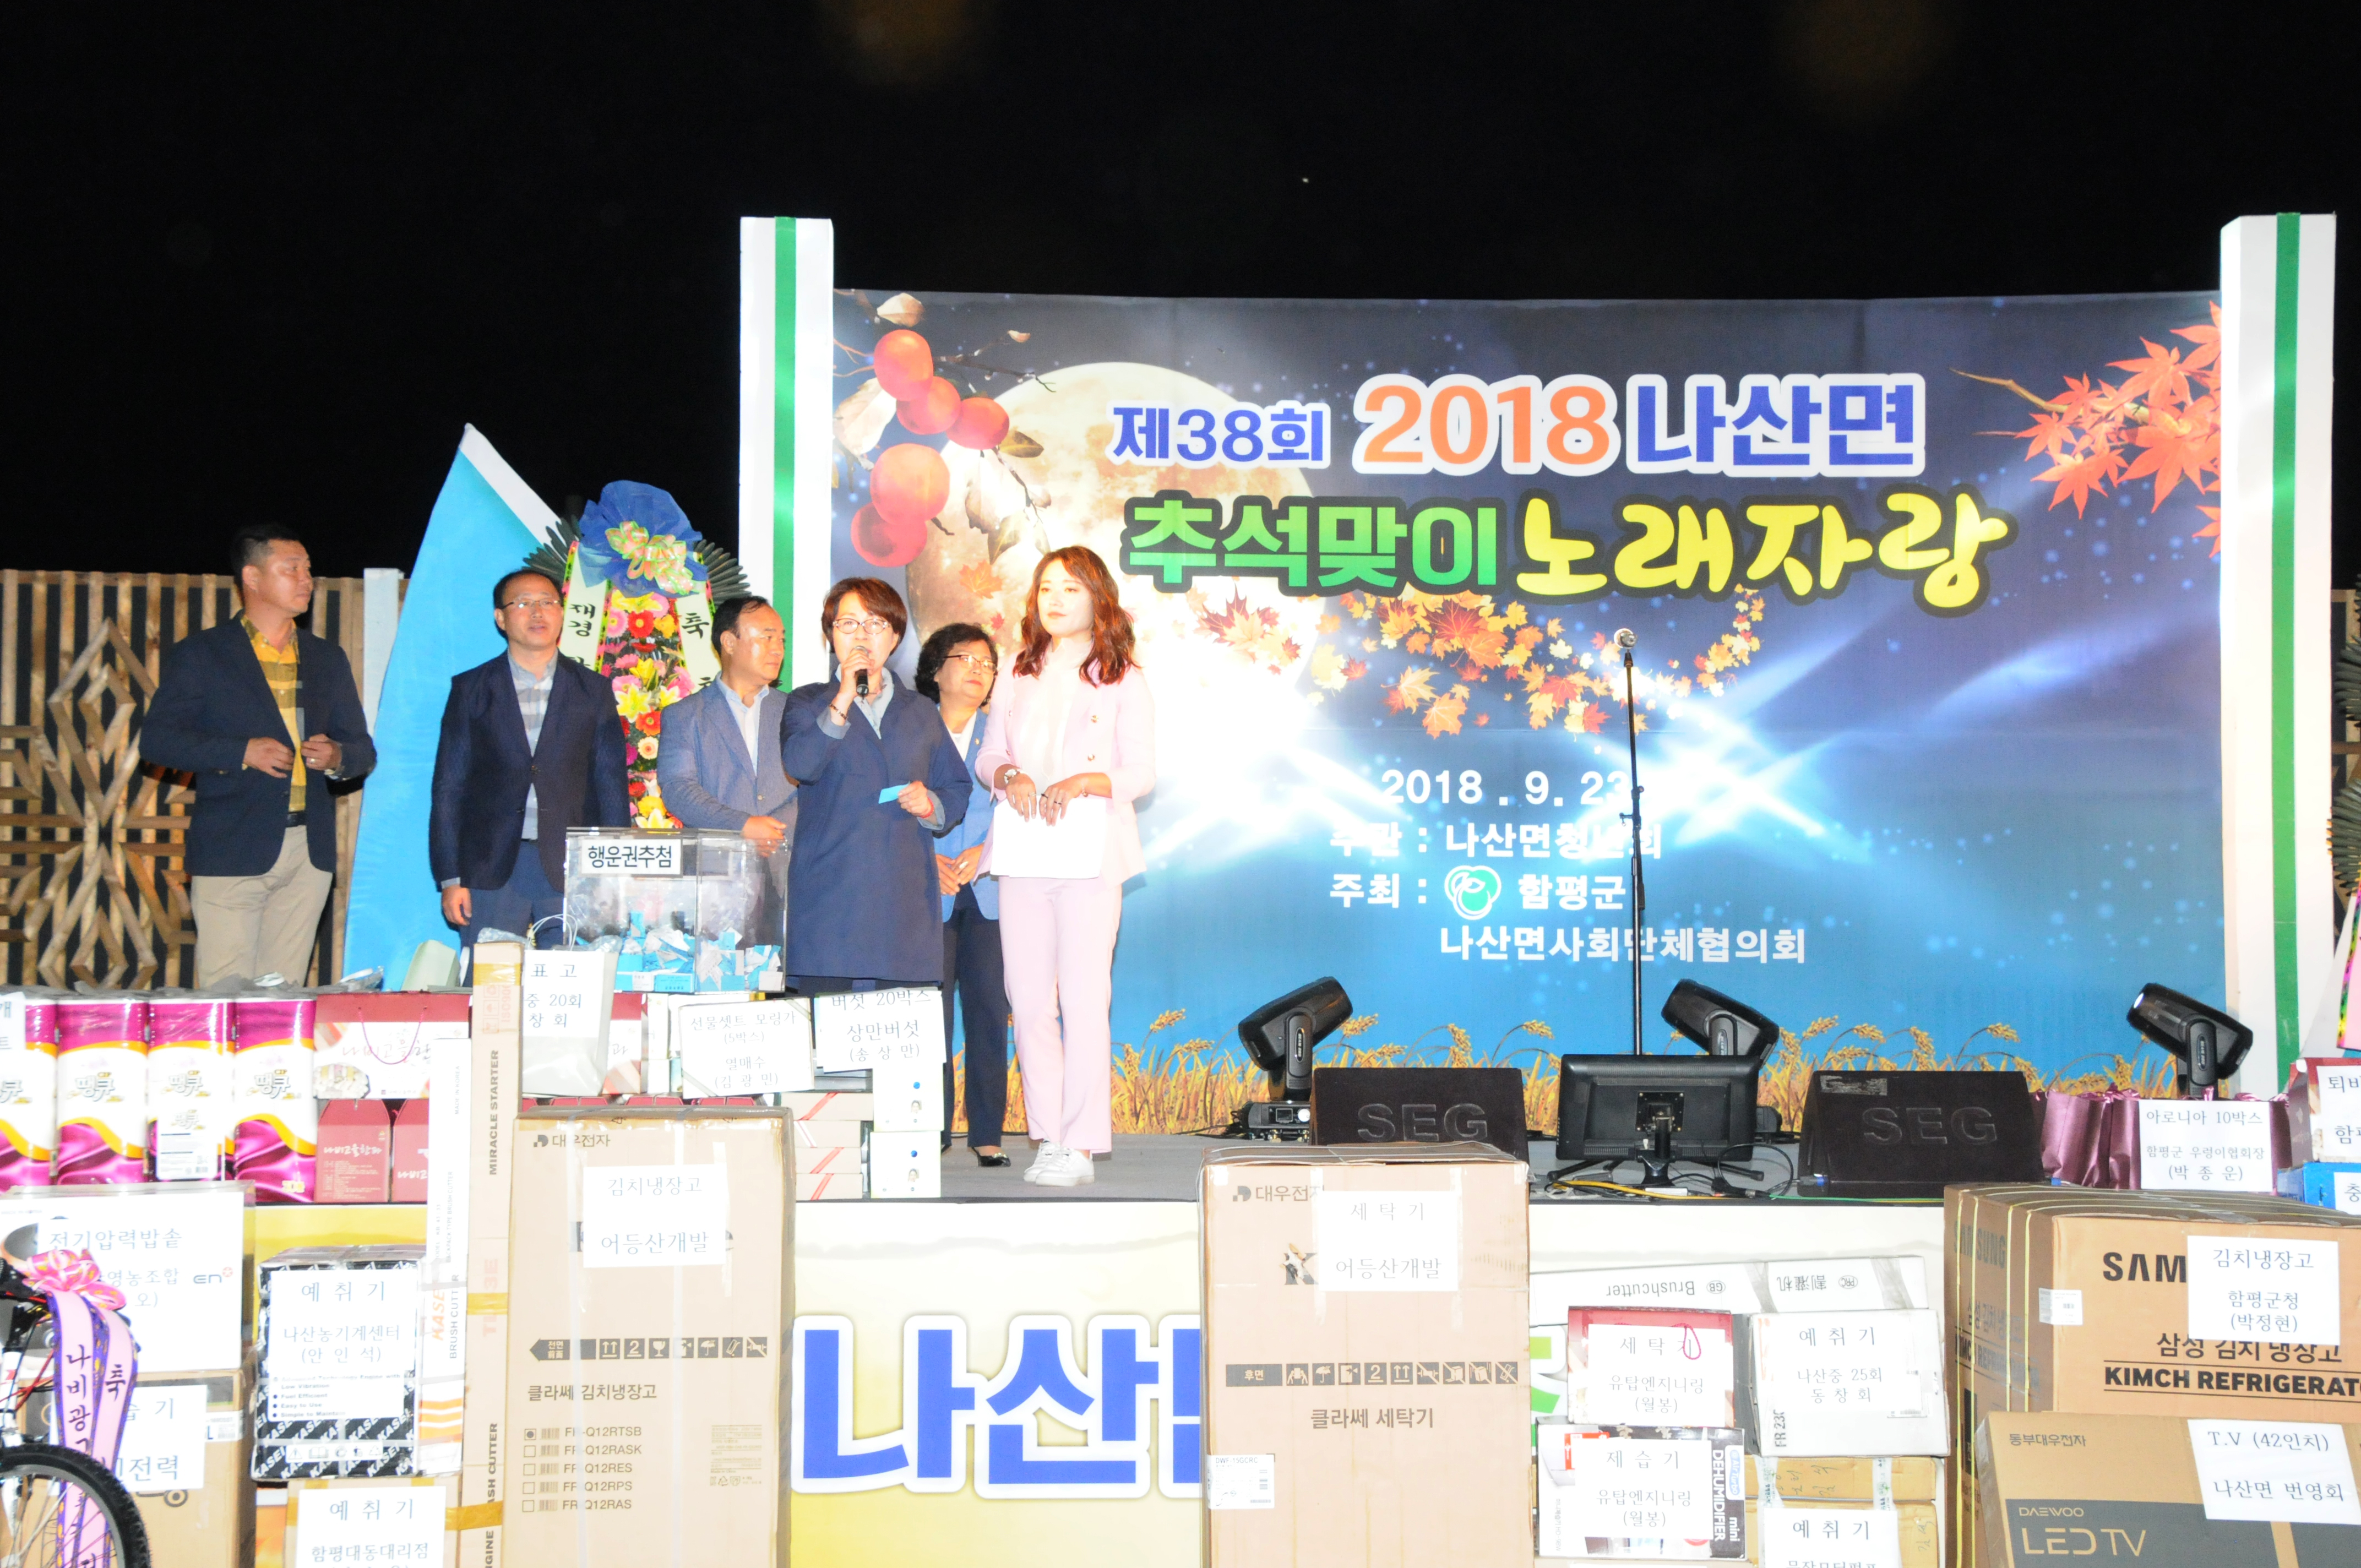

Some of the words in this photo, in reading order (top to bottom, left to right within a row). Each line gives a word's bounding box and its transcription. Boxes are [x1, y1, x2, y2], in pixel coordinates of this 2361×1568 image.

[1113, 406, 1324, 461] 제38회
[1364, 385, 1609, 465] 2018
[1637, 385, 1913, 465] 나산면
[1129, 499, 1497, 587] 추석맞이
[1517, 492, 2008, 607] 노래자랑
[682, 613, 709, 639] 축
[1381, 770, 1482, 804] 2018
[588, 845, 672, 868] 행운권추첨
[1329, 874, 1400, 908] 주최
[1518, 875, 1626, 910] 함평군
[1441, 926, 1804, 963] 나산면사회단체협의회
[549, 993, 581, 1009] 20회
[690, 1014, 747, 1031] 선물셋트
[755, 1011, 796, 1027] 모링가
[847, 1020, 920, 1042] 상만버섯
[723, 1031, 764, 1044] (5박스)
[342, 1039, 432, 1063] 나비고을한
[725, 1057, 766, 1070] 열매수
[490, 1050, 499, 1112] STARTER
[1357, 1103, 1488, 1142] SEG
[1863, 1107, 1998, 1145] SEG
[2147, 1110, 2207, 1125] 아로니아
[2216, 1110, 2263, 1125] 10박스
[489, 1114, 498, 1175] MIRACLE
[2147, 1146, 2183, 1159] 함평군
[2190, 1146, 2265, 1160] 우렁이협회장
[608, 1177, 702, 1196] 김치냉장고
[49, 1228, 182, 1250] 전기압력밥솥
[601, 1232, 710, 1255] 어등산개발
[1336, 1257, 1442, 1280] 어등산개발
[2213, 1249, 2314, 1270] 김치냉장고
[450, 1274, 459, 1317] CUTTR
[1606, 1281, 1695, 1297] Brushcutter
[2228, 1291, 2299, 1310] 함평군청
[2231, 1313, 2298, 1333] (박정현)
[284, 1325, 400, 1343] 나산농기계센터
[548, 1341, 563, 1349] 전면
[2156, 1333, 2204, 1359] 삼성
[105, 1364, 126, 1402] 축
[1244, 1370, 1264, 1381] 후면
[1609, 1375, 1703, 1394] 유탑엔지니링
[1797, 1368, 1842, 1384] 나산중
[1851, 1368, 1882, 1382] 25회
[2105, 1367, 2190, 1390] KIMCH
[528, 1385, 574, 1401] 클라쎄
[581, 1384, 657, 1400] 김치냉장고
[1635, 1397, 1678, 1414] (월봉)
[1311, 1409, 1368, 1429] 클라쎄
[1376, 1408, 1433, 1428] 세탁기
[565, 1427, 641, 1438] F-Q12RTSB
[2009, 1434, 2086, 1447] 동부대우전자
[2208, 1431, 2242, 1446] T.V
[2254, 1433, 2329, 1452] (42인치)
[488, 1423, 498, 1474] CUTTER
[564, 1463, 632, 1473] FQ12RES
[563, 1482, 632, 1491] FQ12RPS
[1713, 1450, 1726, 1540] DEHUMIDIFIER
[2214, 1480, 2272, 1499] 나산면
[2285, 1482, 2344, 1502] 번영회
[563, 1500, 632, 1510] FRQ12RAS
[1596, 1490, 1690, 1507] 유탑엔지니링
[1623, 1511, 1666, 1528] (월봉)
[2019, 1507, 2084, 1517] DAEWOO
[1729, 1517, 1740, 1542] mini
[2022, 1527, 2097, 1555] LED
[2101, 1529, 2146, 1556] TV
[311, 1543, 428, 1562] 함평대동대리점
